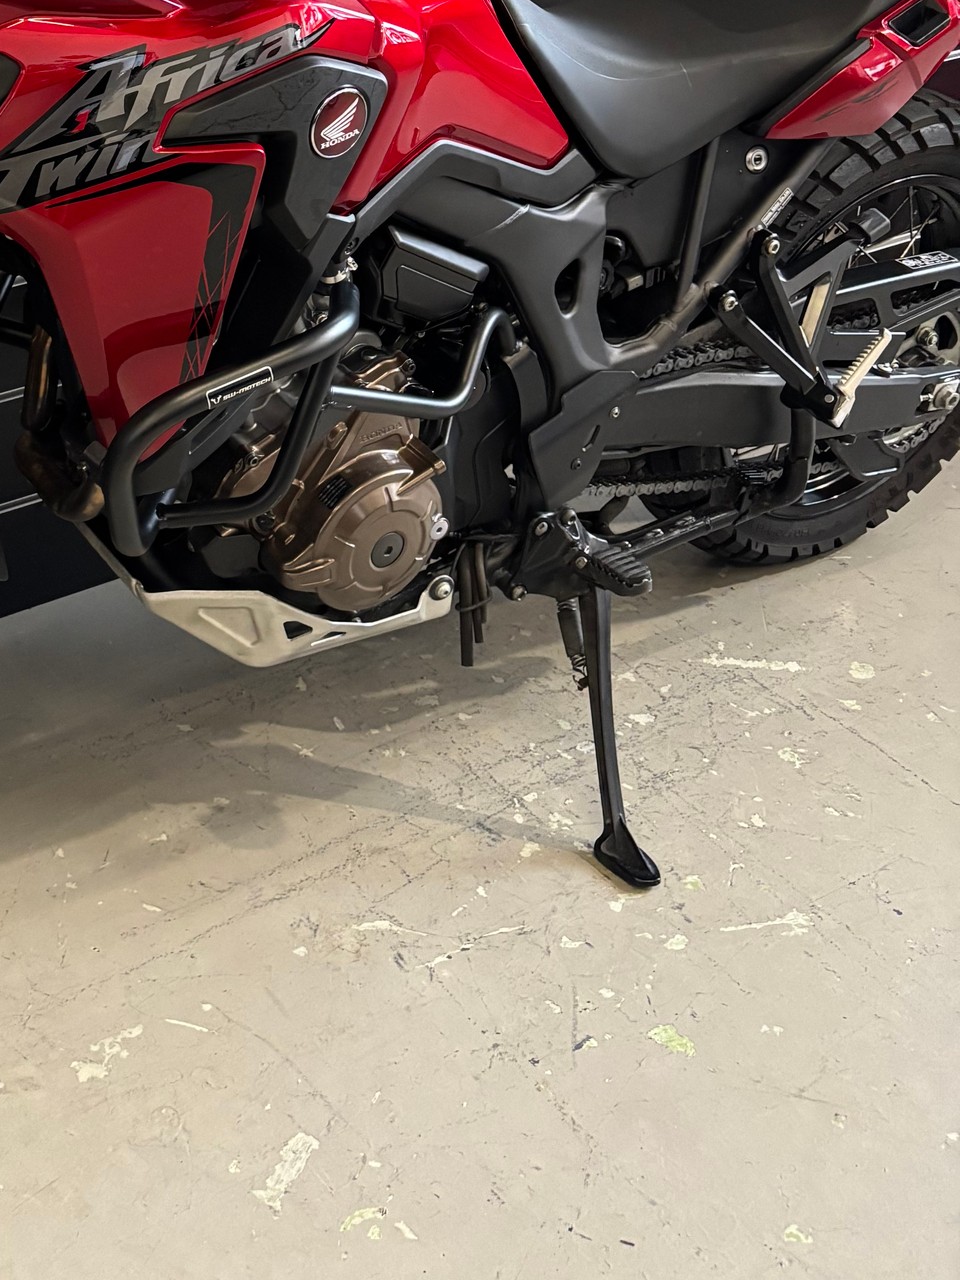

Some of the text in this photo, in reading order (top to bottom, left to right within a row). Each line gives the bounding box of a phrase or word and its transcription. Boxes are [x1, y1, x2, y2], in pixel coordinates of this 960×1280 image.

[10, 23, 325, 154] Africa
[320, 128, 360, 150] HONDA
[222, 376, 271, 401] SW-MOTECH
